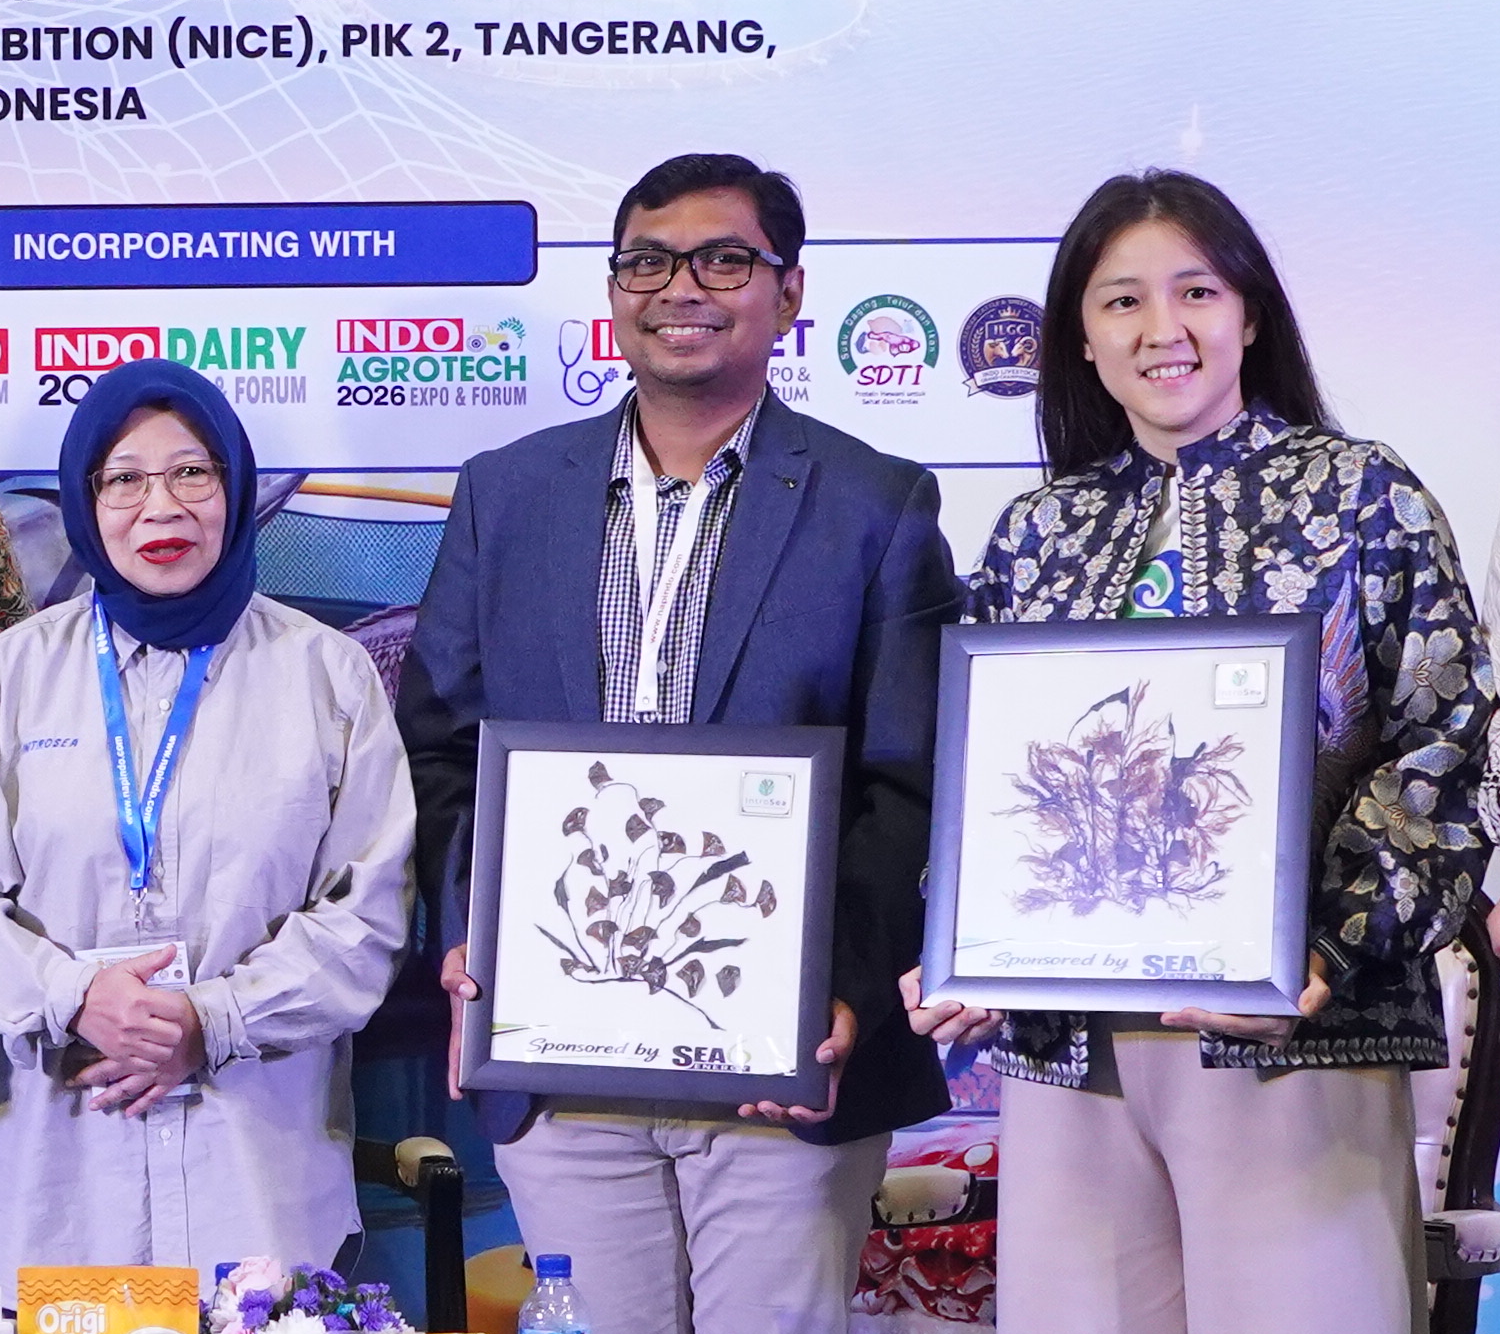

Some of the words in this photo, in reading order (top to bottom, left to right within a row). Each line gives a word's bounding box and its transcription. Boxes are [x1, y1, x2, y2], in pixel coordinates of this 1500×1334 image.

[167, 15, 329, 67] (NICE),
[341, 23, 415, 58] PIK
[425, 23, 463, 63] 2,
[474, 19, 777, 61] TANGERANG,
[13, 231, 300, 261] INCORPORATING
[310, 230, 396, 258] WITH
[340, 319, 460, 352] INDO
[994, 324, 1026, 336] ILGC
[41, 333, 156, 367] INDO
[168, 327, 307, 371] DAIRY
[337, 355, 527, 383] AGROTECH
[797, 367, 811, 382] &
[857, 364, 924, 386] SDTI
[235, 375, 307, 404] FORUM
[337, 385, 406, 406] 2026
[410, 386, 449, 406] EXPO
[455, 386, 466, 406] &
[472, 386, 527, 406] FORUM
[649, 553, 683, 644] www.napindo.com
[114, 735, 133, 825] www.napindo.com
[143, 734, 177, 823] www.napindo.com
[989, 951, 1097, 969] Sponsored
[1103, 953, 1130, 972] by
[527, 1037, 627, 1056] Sponsored
[634, 1041, 660, 1061] by
